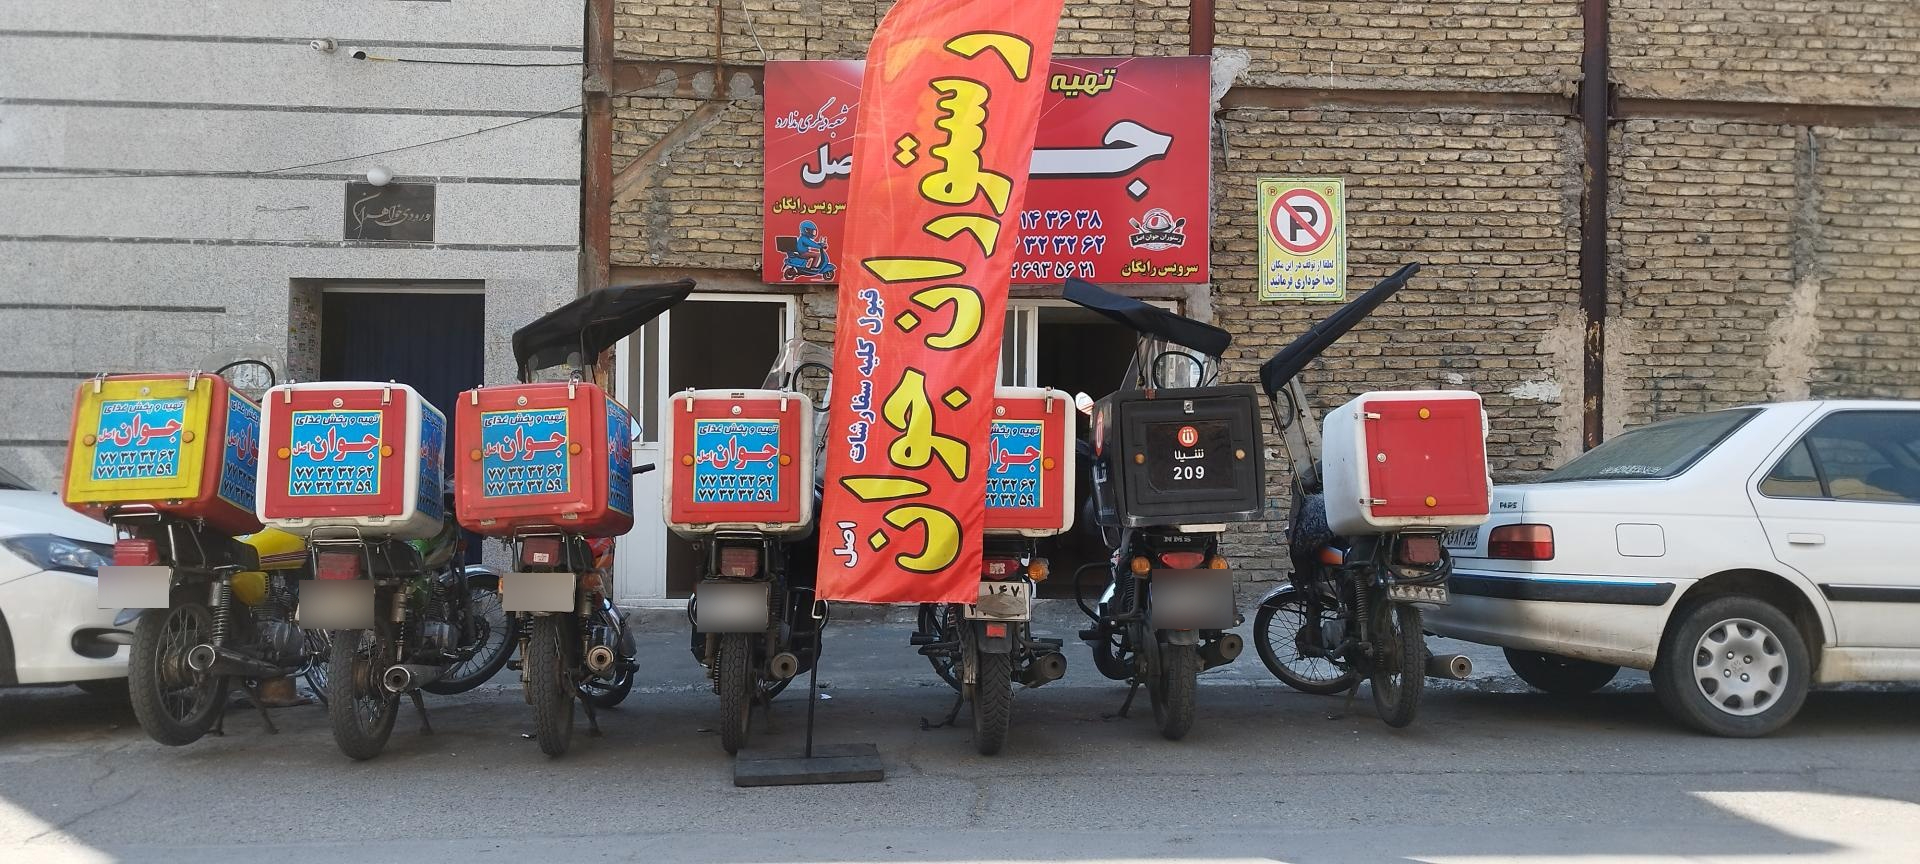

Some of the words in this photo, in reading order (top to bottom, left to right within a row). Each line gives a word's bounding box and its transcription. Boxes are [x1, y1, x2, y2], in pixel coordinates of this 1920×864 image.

[1050, 68, 1117, 98] تهیه
[798, 96, 836, 133] دیگری
[827, 104, 848, 138] شعبه
[802, 143, 853, 184] صل
[861, 30, 1034, 350] رستوران
[773, 196, 807, 215] رایگان
[807, 201, 847, 215] سرویس
[1045, 209, 1072, 230] ۳۶
[1075, 209, 1103, 230] ۳۸
[1024, 235, 1049, 255] ۳۲
[1052, 235, 1077, 255] ۳۲
[1081, 235, 1106, 255] ۶۲
[1121, 260, 1157, 277] رایگان
[1158, 263, 1199, 277] سرویس
[857, 288, 884, 334] قبول
[855, 337, 881, 377] کلیه
[103, 403, 128, 414] غذای
[129, 401, 153, 414] پخش
[163, 401, 184, 411] تهیه
[295, 414, 321, 426] غذای
[322, 413, 348, 427] پخش
[349, 416, 356, 426] و
[357, 413, 380, 426] تهیه
[484, 414, 509, 427] غذای
[509, 412, 534, 426] پخش
[536, 415, 542, 424] و
[544, 411, 566, 424] تهیه
[97, 428, 115, 442] اصل
[114, 413, 183, 447] جوان
[699, 424, 723, 436] غذای
[723, 422, 748, 437] پخش
[749, 426, 756, 435] و
[757, 424, 779, 436] تهیه
[1011, 427, 1018, 436] و
[1020, 425, 1041, 437] تهیه
[236, 422, 259, 467] وان
[292, 441, 311, 455] اصل
[309, 426, 380, 461] جوان
[483, 442, 501, 457] اصل
[500, 425, 566, 462] جوان
[100, 452, 118, 464] ۷۷
[120, 450, 137, 463] ۳۲
[140, 449, 157, 462] ۳۲
[158, 448, 176, 462] ۶۲
[696, 449, 714, 464] اصل
[712, 434, 779, 470] جوان
[988, 436, 1041, 473] جوا
[1174, 448, 1205, 462] شیلا
[97, 465, 115, 478] ۷۷
[117, 464, 135, 477] ۳۲
[137, 463, 154, 476] ۳۲
[156, 463, 172, 475] ۵۹
[295, 466, 314, 479] ۷۷
[317, 466, 335, 479] ۳۲
[337, 466, 355, 479] ۳۲
[357, 466, 374, 479] ۶۲
[487, 467, 506, 480] ۷۷
[507, 466, 525, 479] ۳۲
[527, 464, 545, 478] ۳۲
[546, 463, 563, 477] ۶۲
[840, 367, 971, 572] جوان
[1173, 466, 1205, 480] 209
[293, 481, 313, 493] ۷۷
[315, 480, 333, 493] ۳۲
[335, 480, 353, 493] ۳۲
[355, 479, 372, 492] ۵۹
[487, 482, 505, 495] ۷۷
[507, 480, 524, 494] ۳۲
[526, 479, 544, 493] ۳۲
[546, 477, 562, 491] ۵۹
[700, 474, 718, 487] ۷۷
[720, 474, 736, 487] ۳۲
[739, 474, 756, 487] ۳۲
[757, 474, 774, 487] ۶۲
[1000, 477, 1018, 491] ۳۲
[1019, 477, 1037, 491] ۶۲
[698, 488, 716, 501] ۷۷
[718, 488, 735, 501] ۳۲
[738, 488, 755, 501] ۳۲
[756, 488, 773, 501] ۵۹
[1000, 492, 1017, 506] ۳۲
[1019, 492, 1035, 506] ۵۹
[834, 521, 858, 568] اصل
